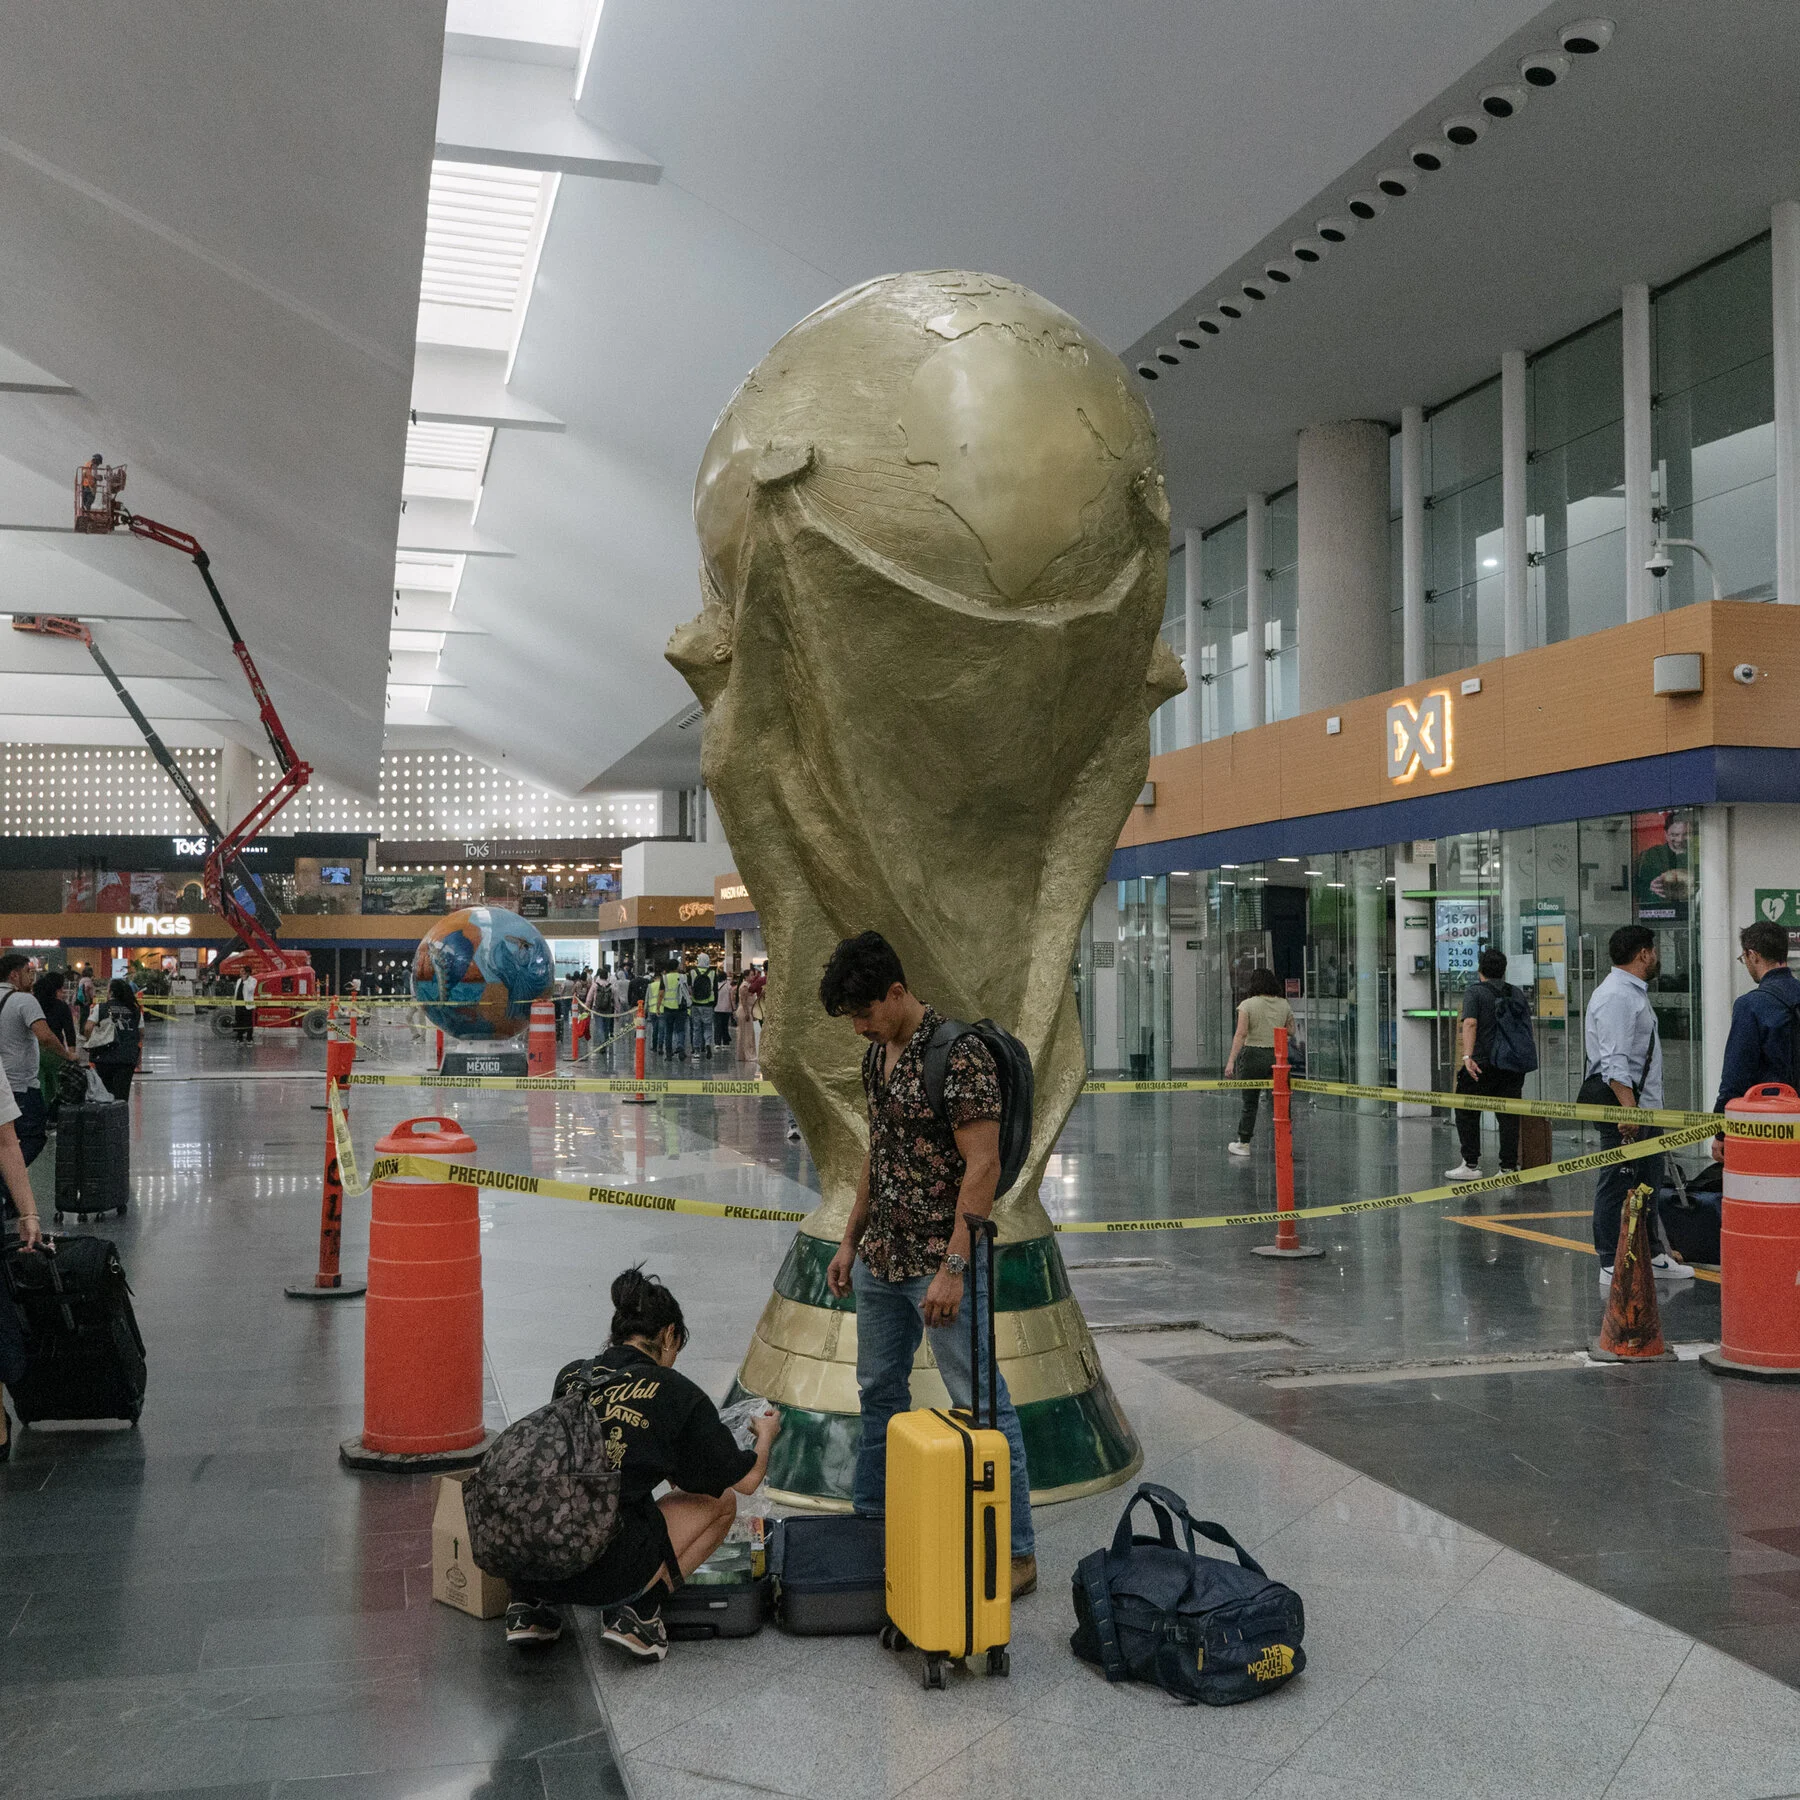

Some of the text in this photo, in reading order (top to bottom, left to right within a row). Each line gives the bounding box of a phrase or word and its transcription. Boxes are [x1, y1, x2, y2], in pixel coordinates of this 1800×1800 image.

[116, 917, 191, 935] WINGS
[1445, 914, 1477, 924] 16.70
[1445, 927, 1477, 937] 18.00
[1448, 948, 1473, 956] 21.40
[1448, 959, 1473, 967] 23.50
[466, 1059, 500, 1072] MÉXICO
[1451, 1174, 1524, 1196] PRECAUCION
[1558, 1149, 1627, 1174] PRECAUCION
[1659, 1122, 1724, 1149] PRECAUCION
[1726, 1121, 1795, 1140] PRECAUCION
[449, 1165, 539, 1194] PRECAUCION
[588, 1187, 677, 1212] PRECAUCION
[604, 1378, 660, 1403] Wall
[1261, 1644, 1281, 1659] THE
[1247, 1655, 1282, 1675] NORTH
[1256, 1667, 1282, 1682] FACE
